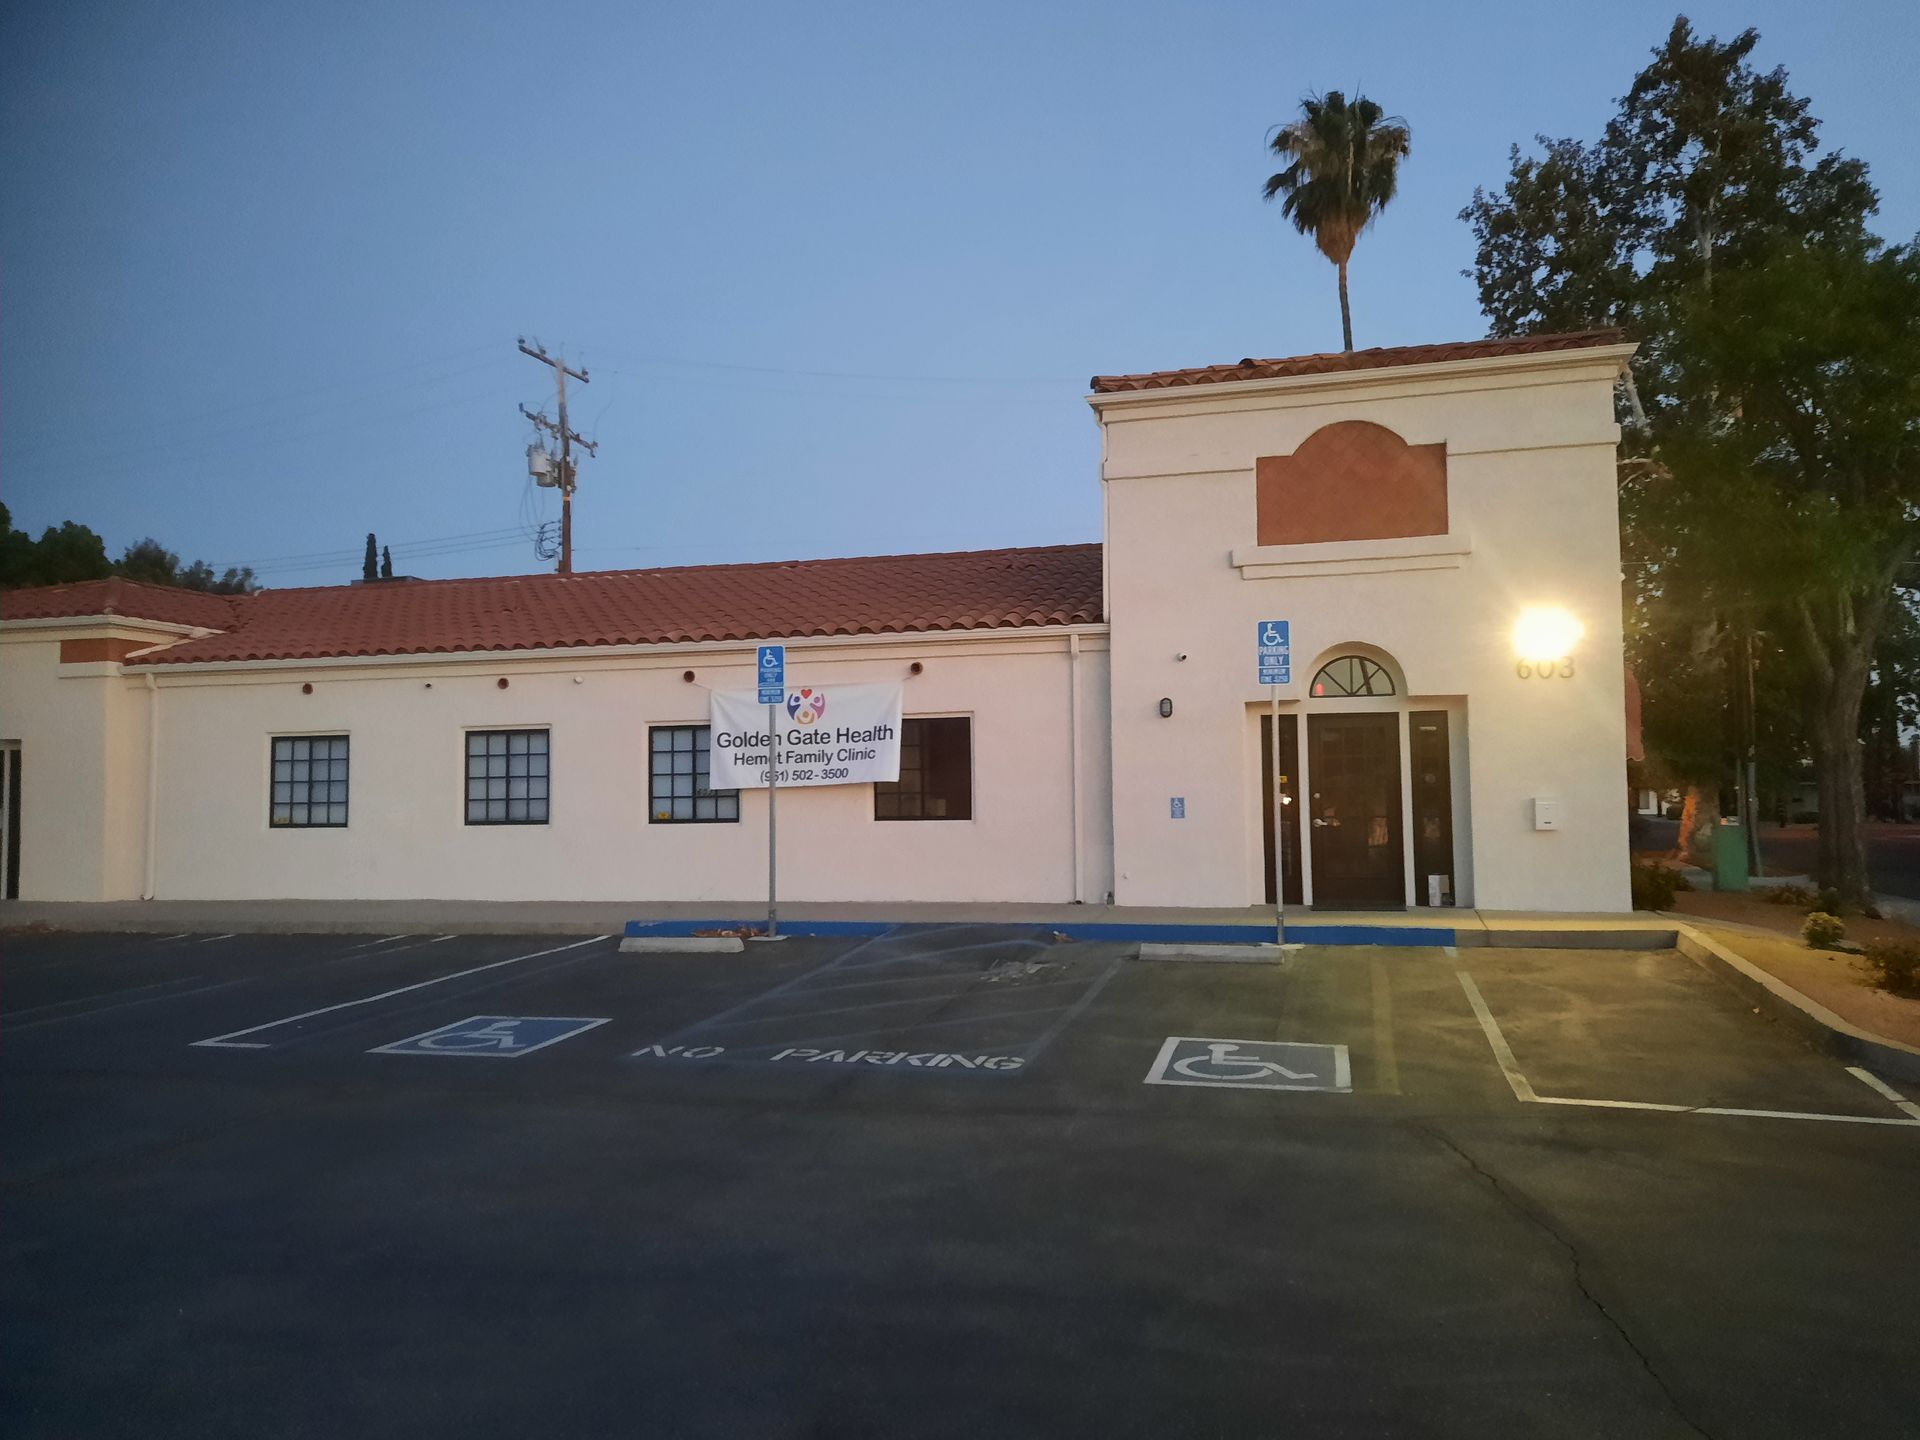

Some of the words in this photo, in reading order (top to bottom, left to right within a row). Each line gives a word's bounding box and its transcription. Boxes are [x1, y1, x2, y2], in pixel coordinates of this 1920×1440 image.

[1515, 655, 1576, 680] 603
[717, 731, 782, 748] Golden
[787, 729, 832, 746] Gate
[836, 724, 894, 744] Health
[734, 752, 783, 766] Hemt
[786, 750, 834, 766] Family
[837, 747, 876, 762] Clinic
[631, 1045, 725, 1058] NO
[769, 1048, 1026, 1070] PARKING
